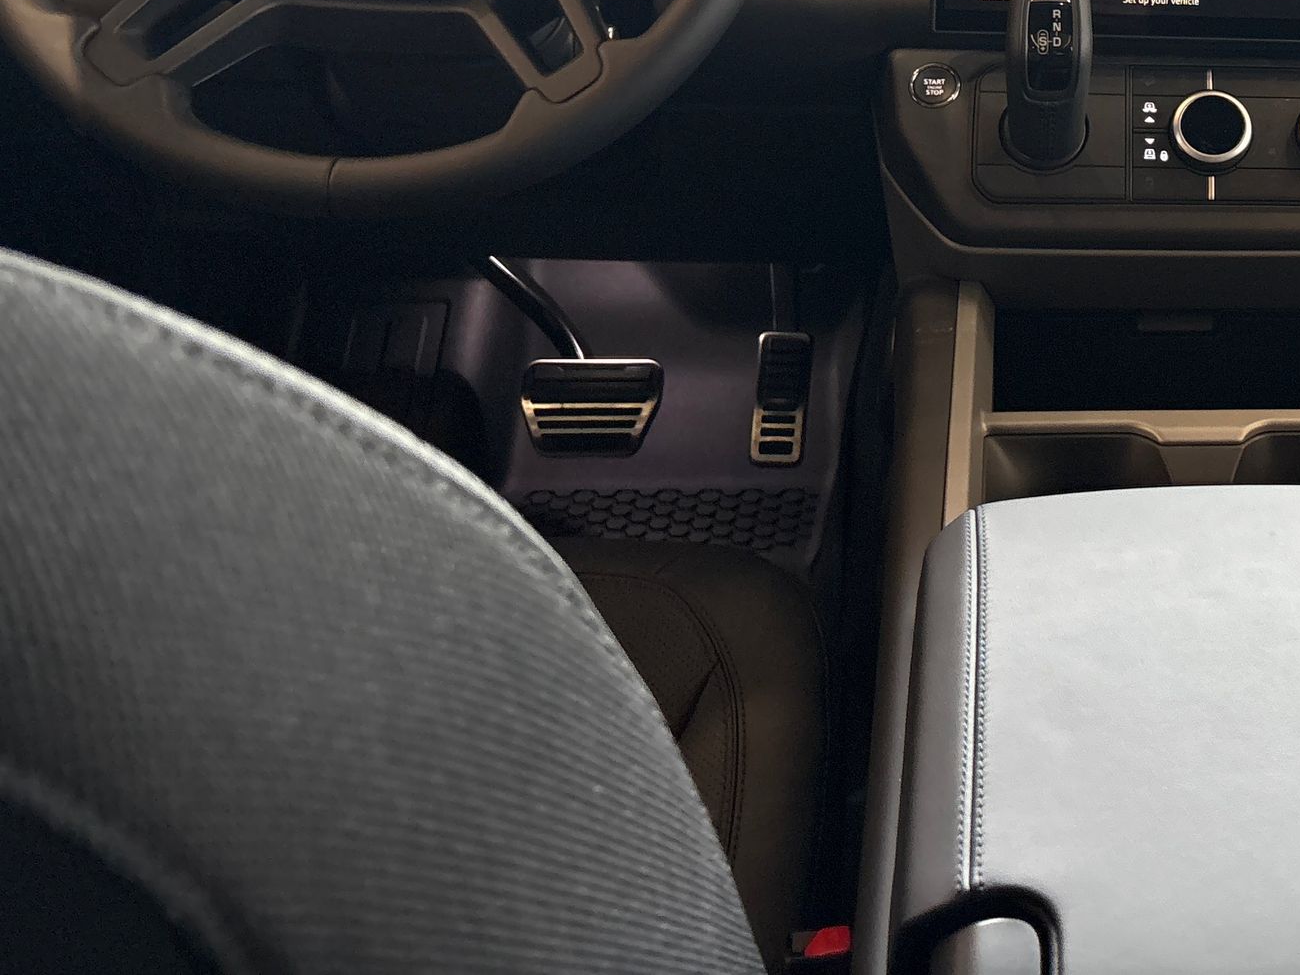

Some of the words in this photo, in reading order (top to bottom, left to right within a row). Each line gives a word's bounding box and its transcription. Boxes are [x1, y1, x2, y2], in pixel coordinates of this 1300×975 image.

[1052, 9, 1061, 18] R
[1052, 22, 1061, 31] N
[1053, 37, 1061, 47] D
